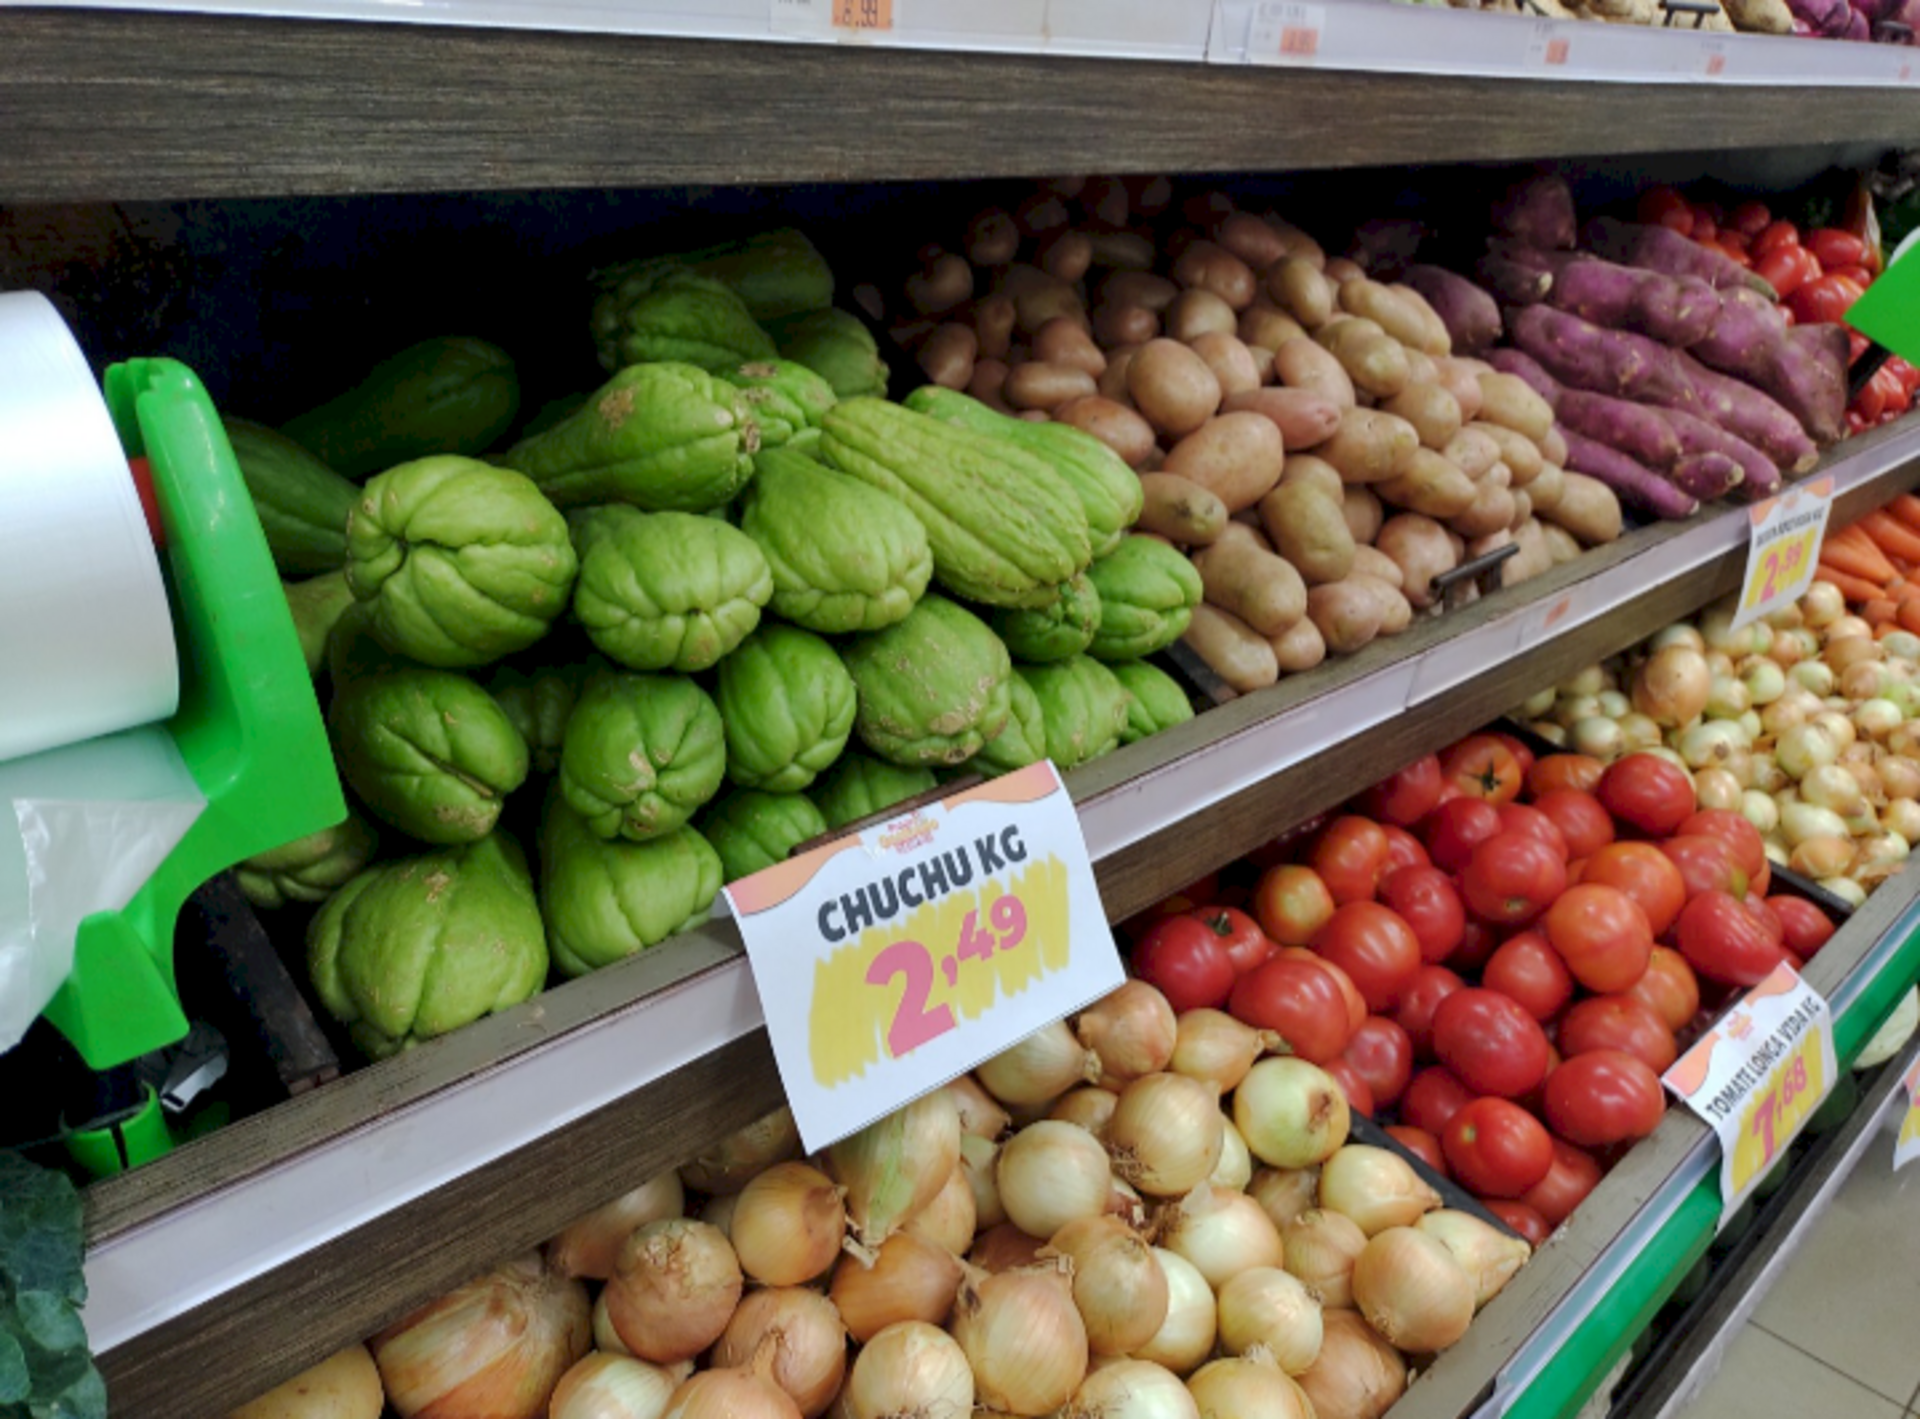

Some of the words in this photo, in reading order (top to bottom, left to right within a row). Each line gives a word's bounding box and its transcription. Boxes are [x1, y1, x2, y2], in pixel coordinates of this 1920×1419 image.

[817, 848, 974, 943] CHUCHU
[973, 824, 1028, 878] KG
[865, 894, 1028, 1060] 2,49
[1705, 1063, 1753, 1121] TOMATE
[1776, 1008, 1809, 1044] VIDA
[1752, 1054, 1808, 1168] 7,68
